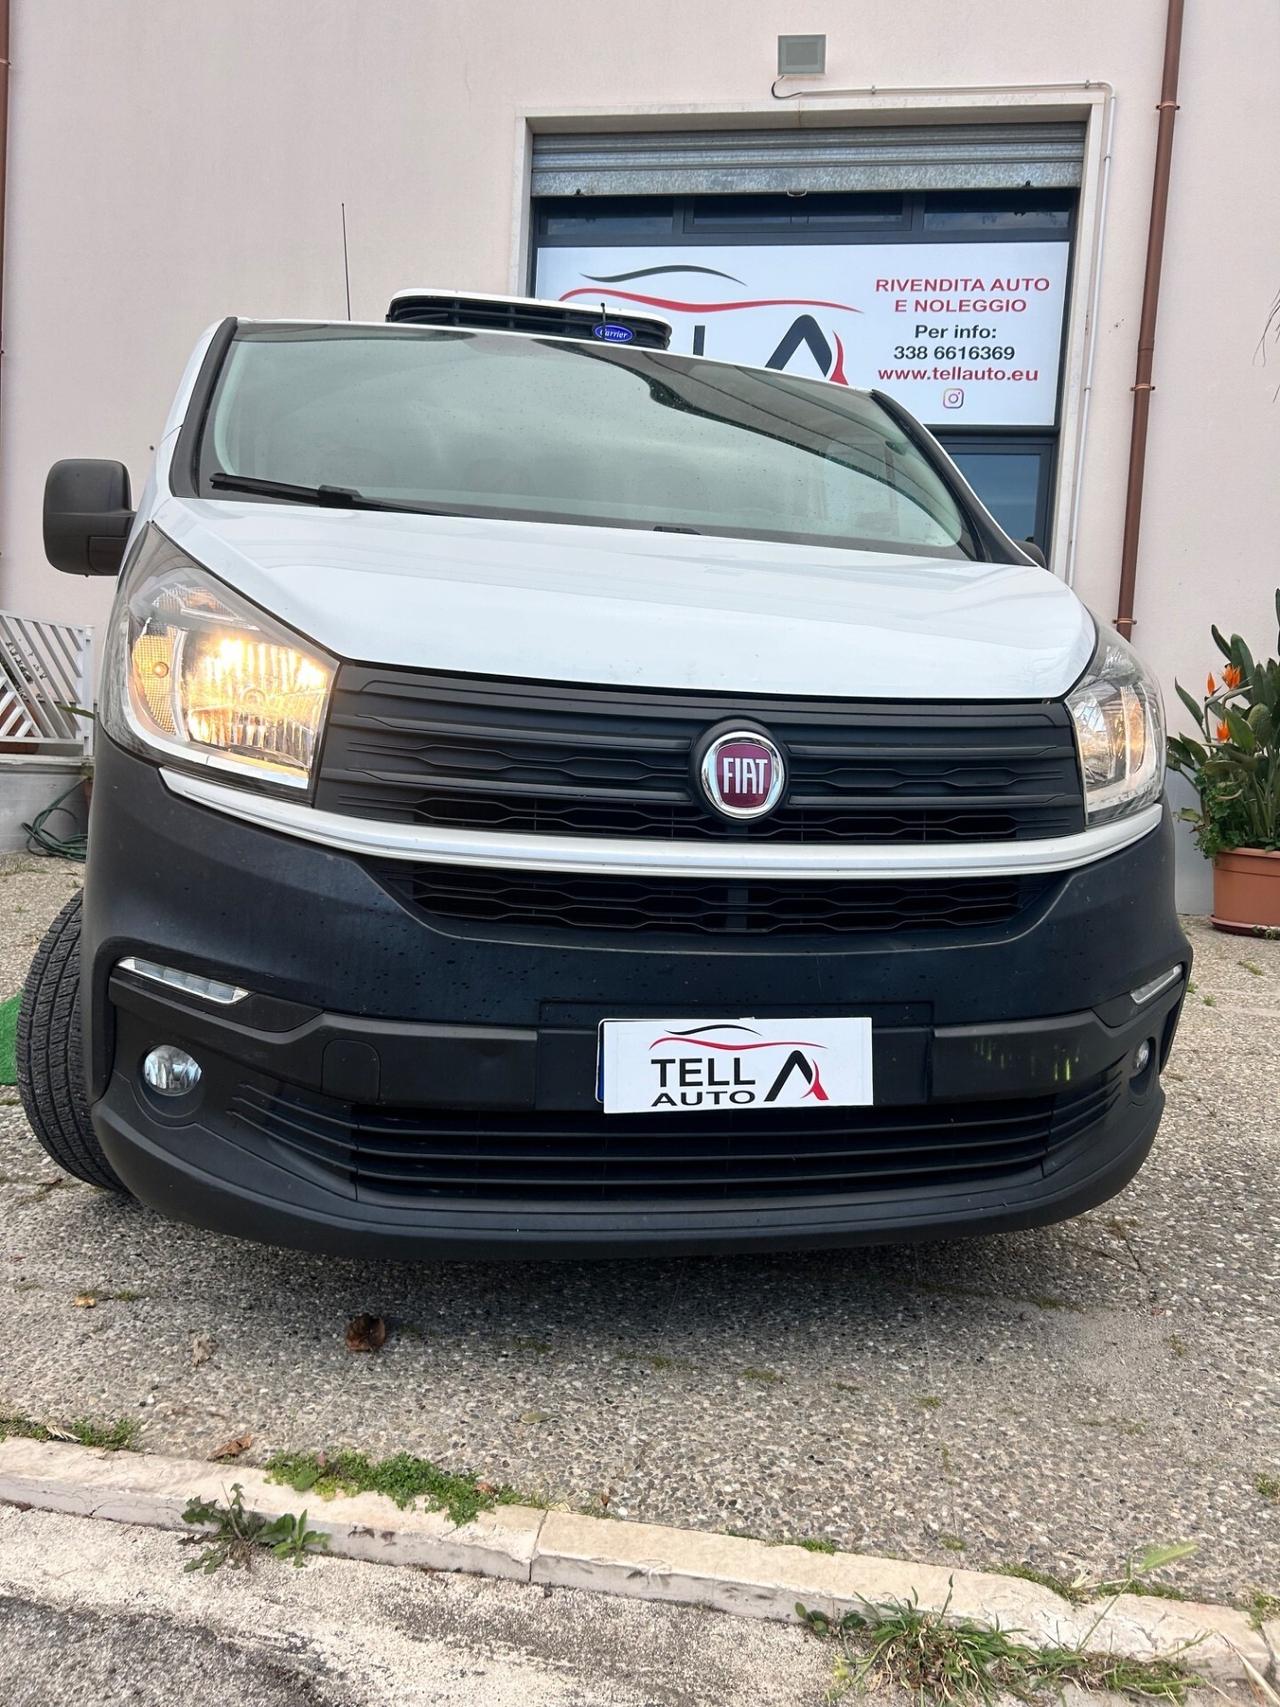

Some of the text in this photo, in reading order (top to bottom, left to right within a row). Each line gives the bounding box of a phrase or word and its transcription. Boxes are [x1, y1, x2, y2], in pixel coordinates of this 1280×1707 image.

[875, 277, 1050, 292] RIVENDITA AUTO
[895, 299, 1027, 313] E NOLEGGIO
[914, 324, 997, 339] Per info:
[893, 345, 1016, 361] 338 6616369
[877, 366, 1039, 382] www.tellauto.eu
[722, 757, 769, 795] FIAT
[651, 1057, 756, 1088] TELL
[651, 1090, 756, 1107] AUTO
